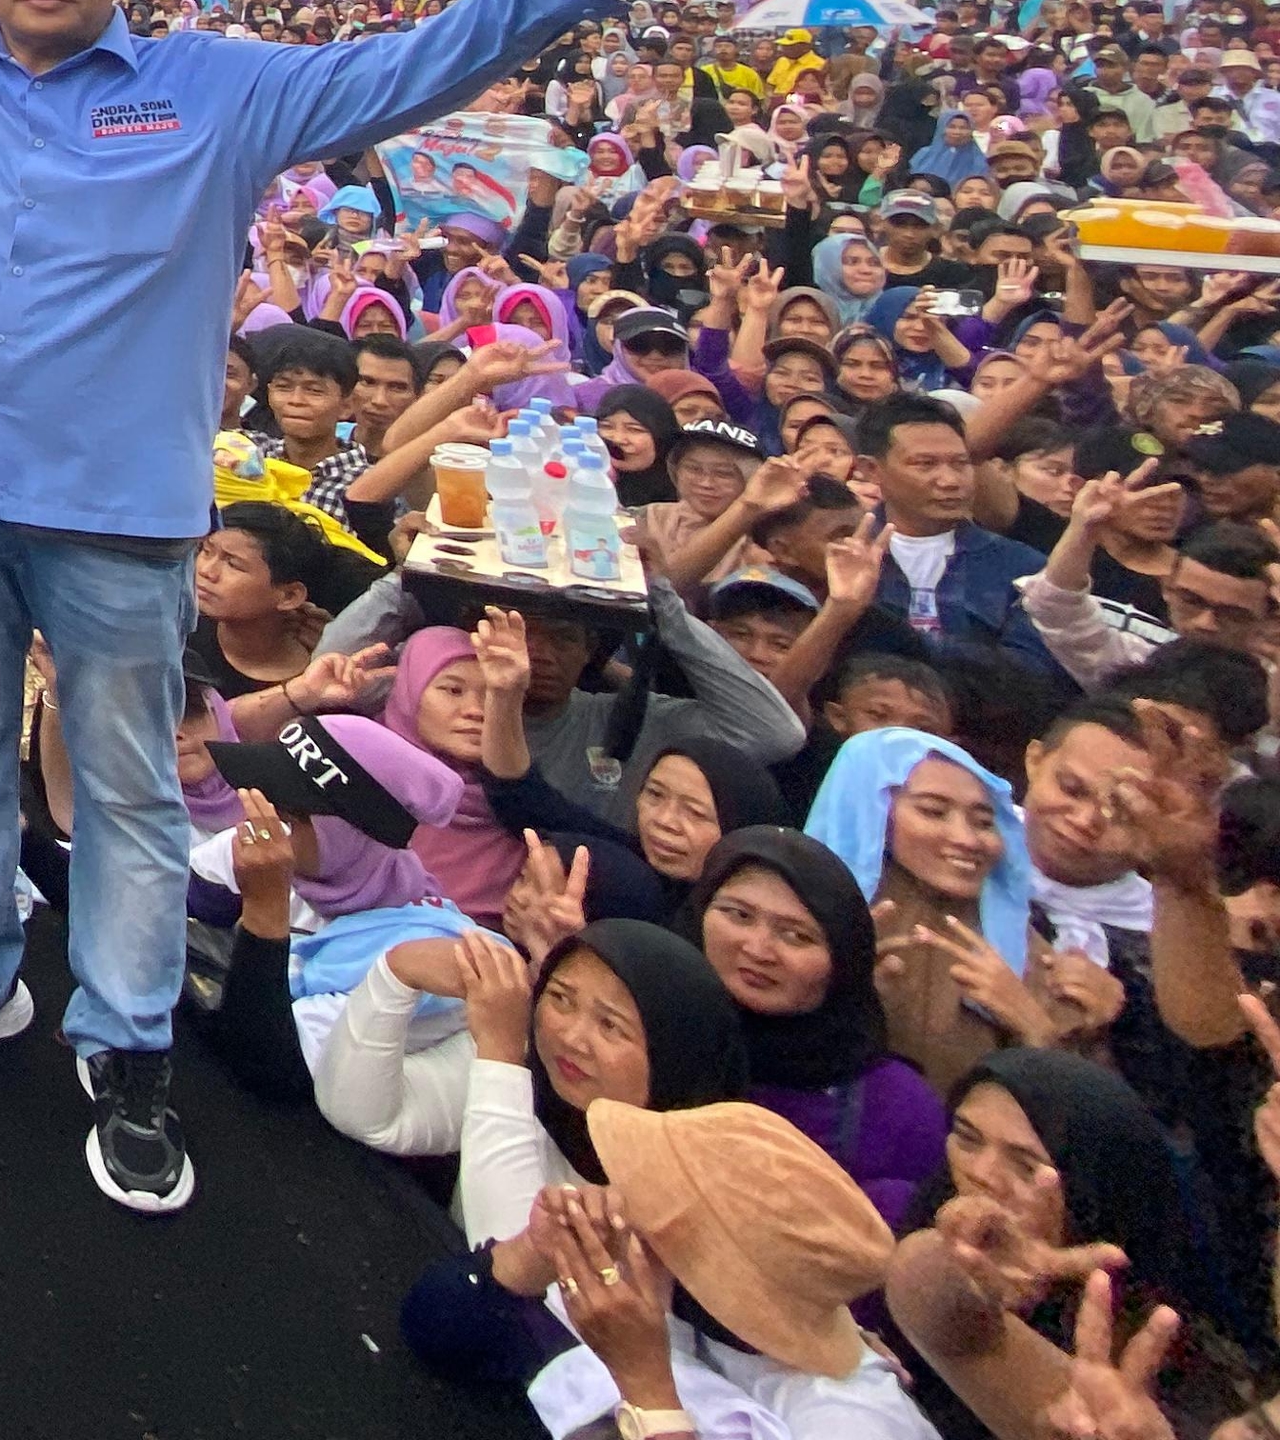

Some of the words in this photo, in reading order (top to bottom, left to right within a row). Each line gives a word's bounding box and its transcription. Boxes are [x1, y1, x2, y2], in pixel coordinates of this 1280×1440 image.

[91, 104, 138, 119] ANDRA
[140, 99, 174, 112] SONI
[92, 112, 157, 128] DIMYATI
